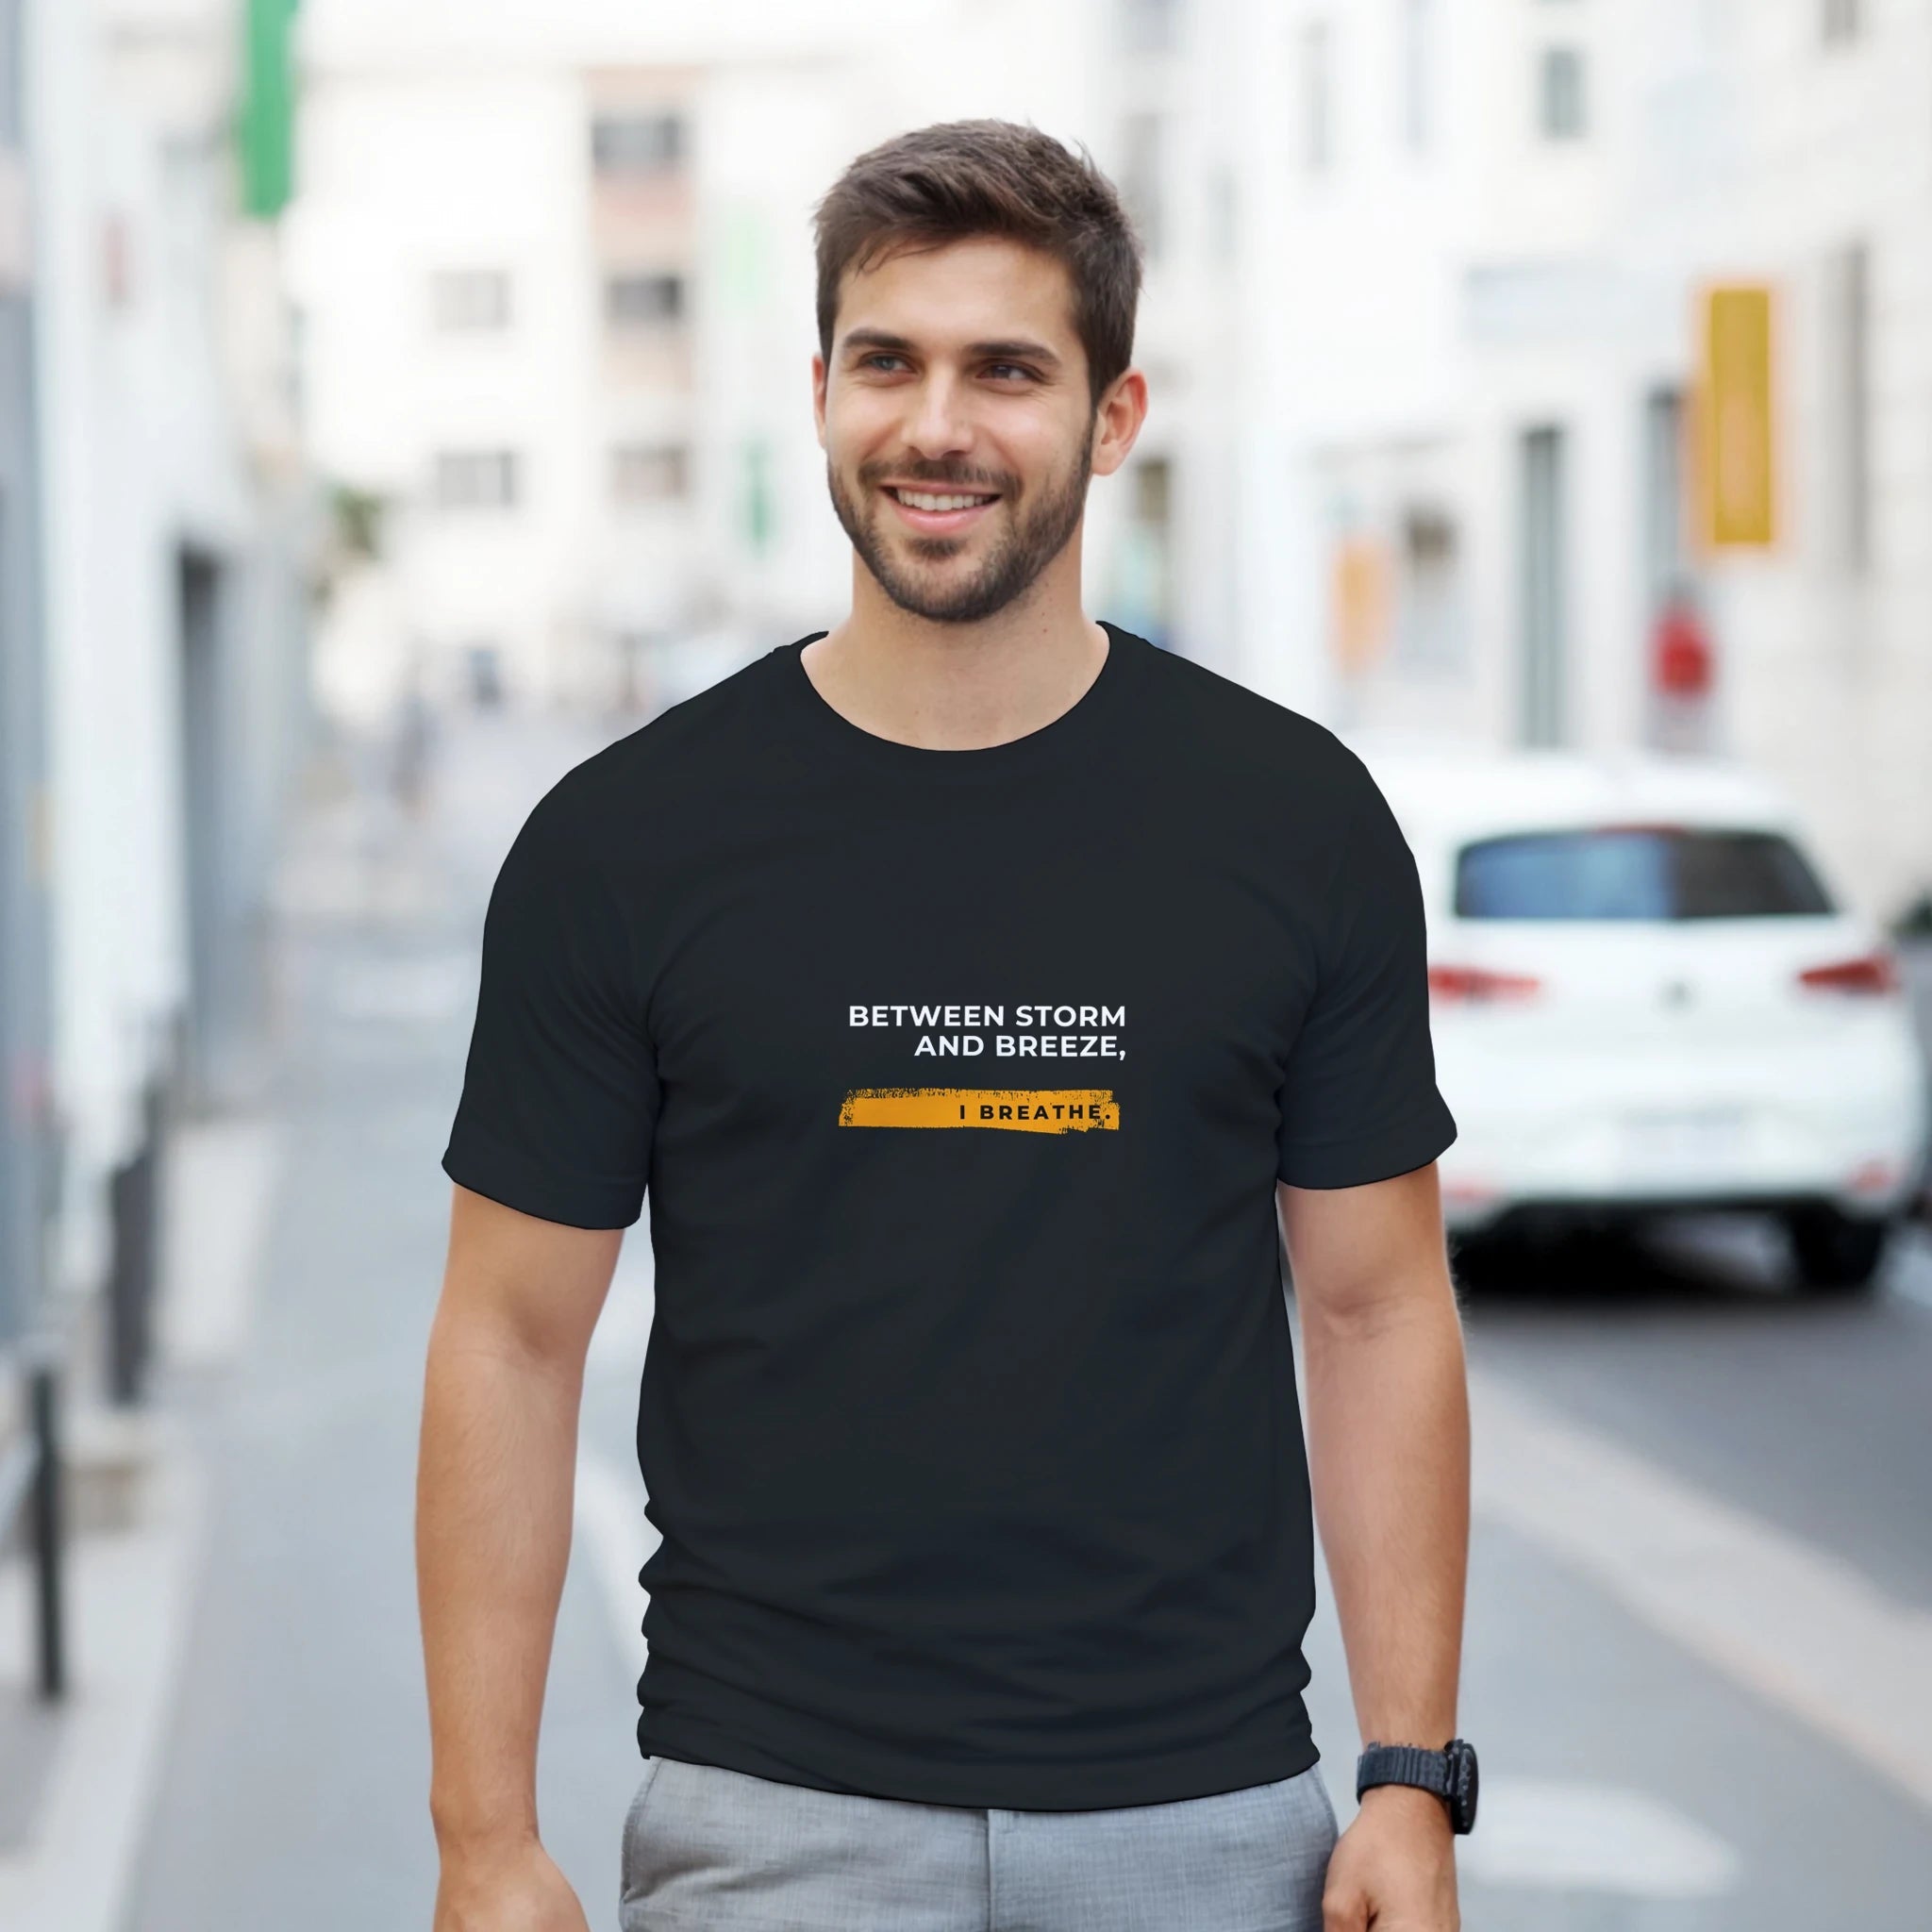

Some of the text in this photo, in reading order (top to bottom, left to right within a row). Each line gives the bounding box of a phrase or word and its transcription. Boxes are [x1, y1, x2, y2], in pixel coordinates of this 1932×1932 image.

[849, 1005, 1125, 1027] BETWEEN STORM
[913, 1035, 1126, 1061] AND BREEZE,
[959, 1105, 1111, 1120] I BREATHE.
